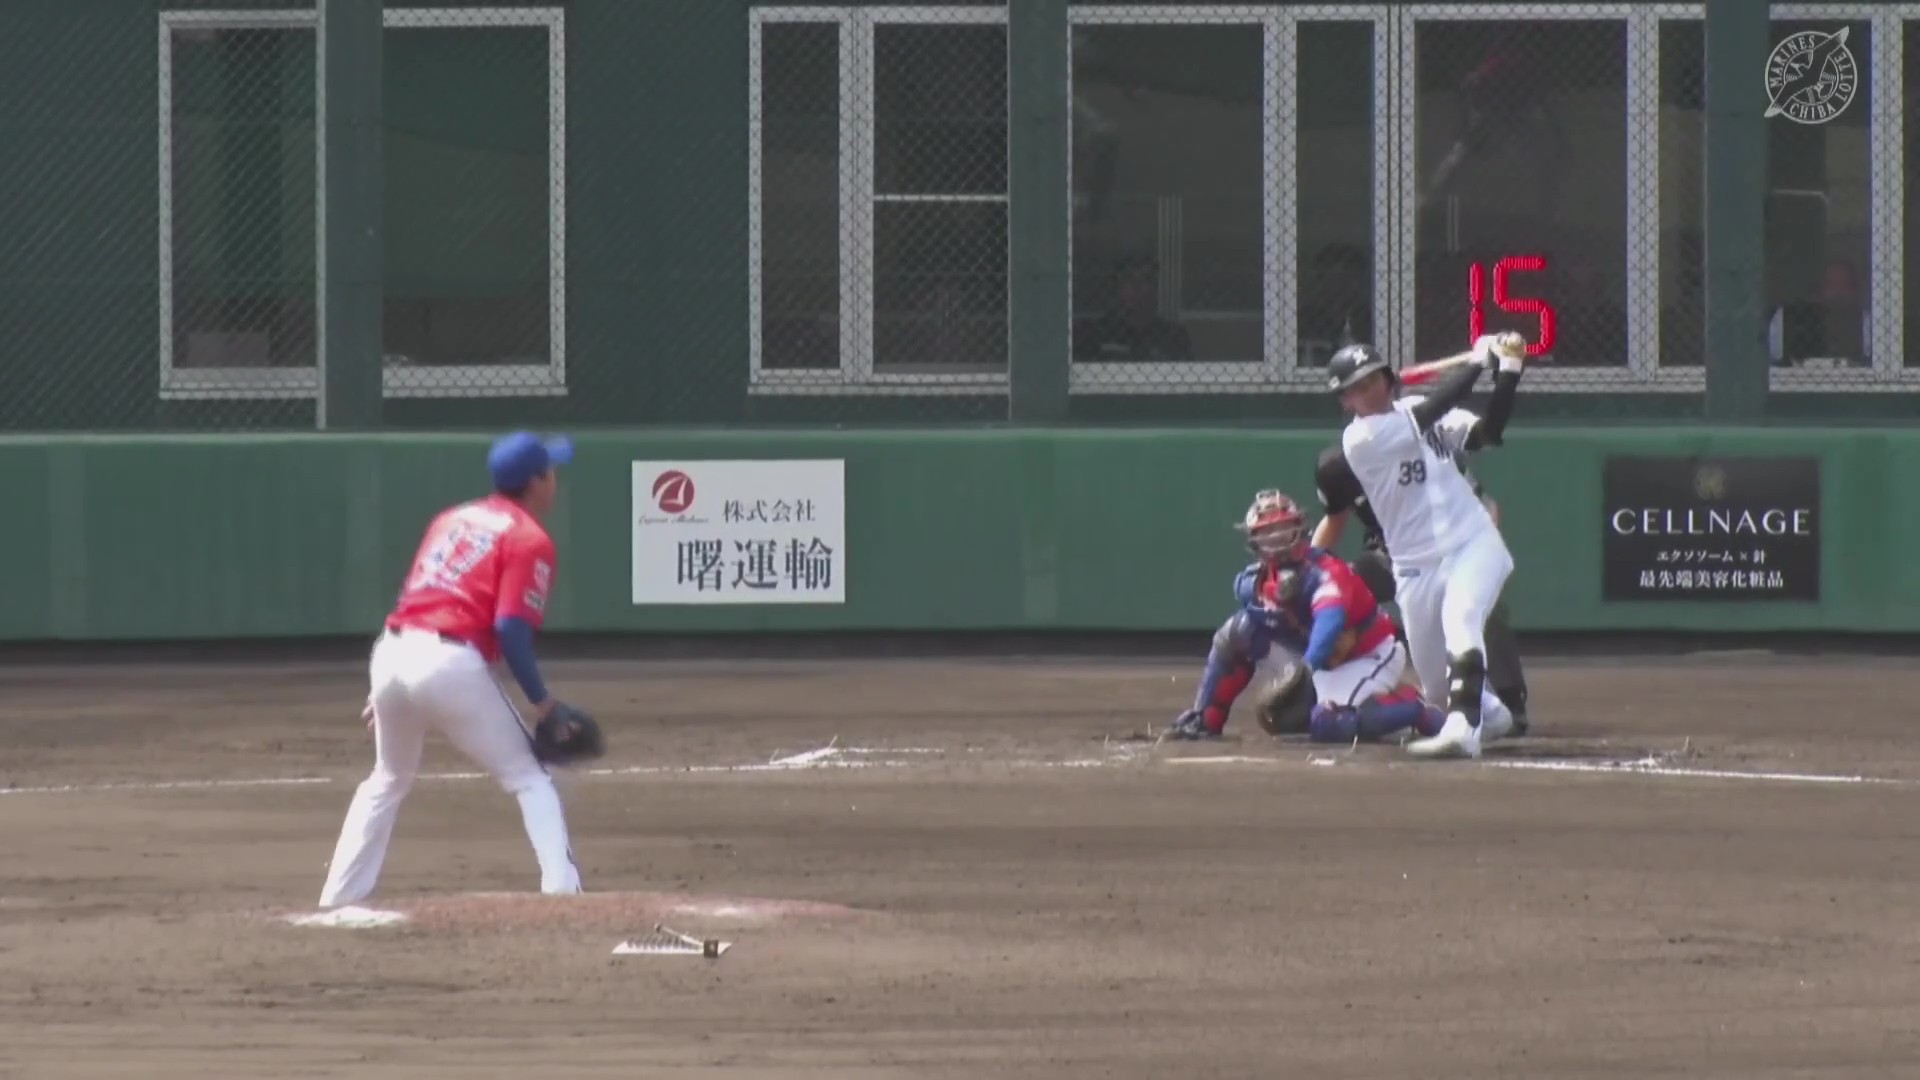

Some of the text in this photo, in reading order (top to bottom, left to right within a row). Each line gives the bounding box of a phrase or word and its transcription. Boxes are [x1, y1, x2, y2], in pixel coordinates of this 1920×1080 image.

[1469, 255, 1556, 355] 15
[1398, 459, 1427, 487] 39
[722, 498, 816, 524] 株式会社
[1612, 507, 1811, 535] CELLNAGE
[677, 536, 834, 592] 曙運輸
[1639, 569, 1784, 589] 最先端美容化粧品
